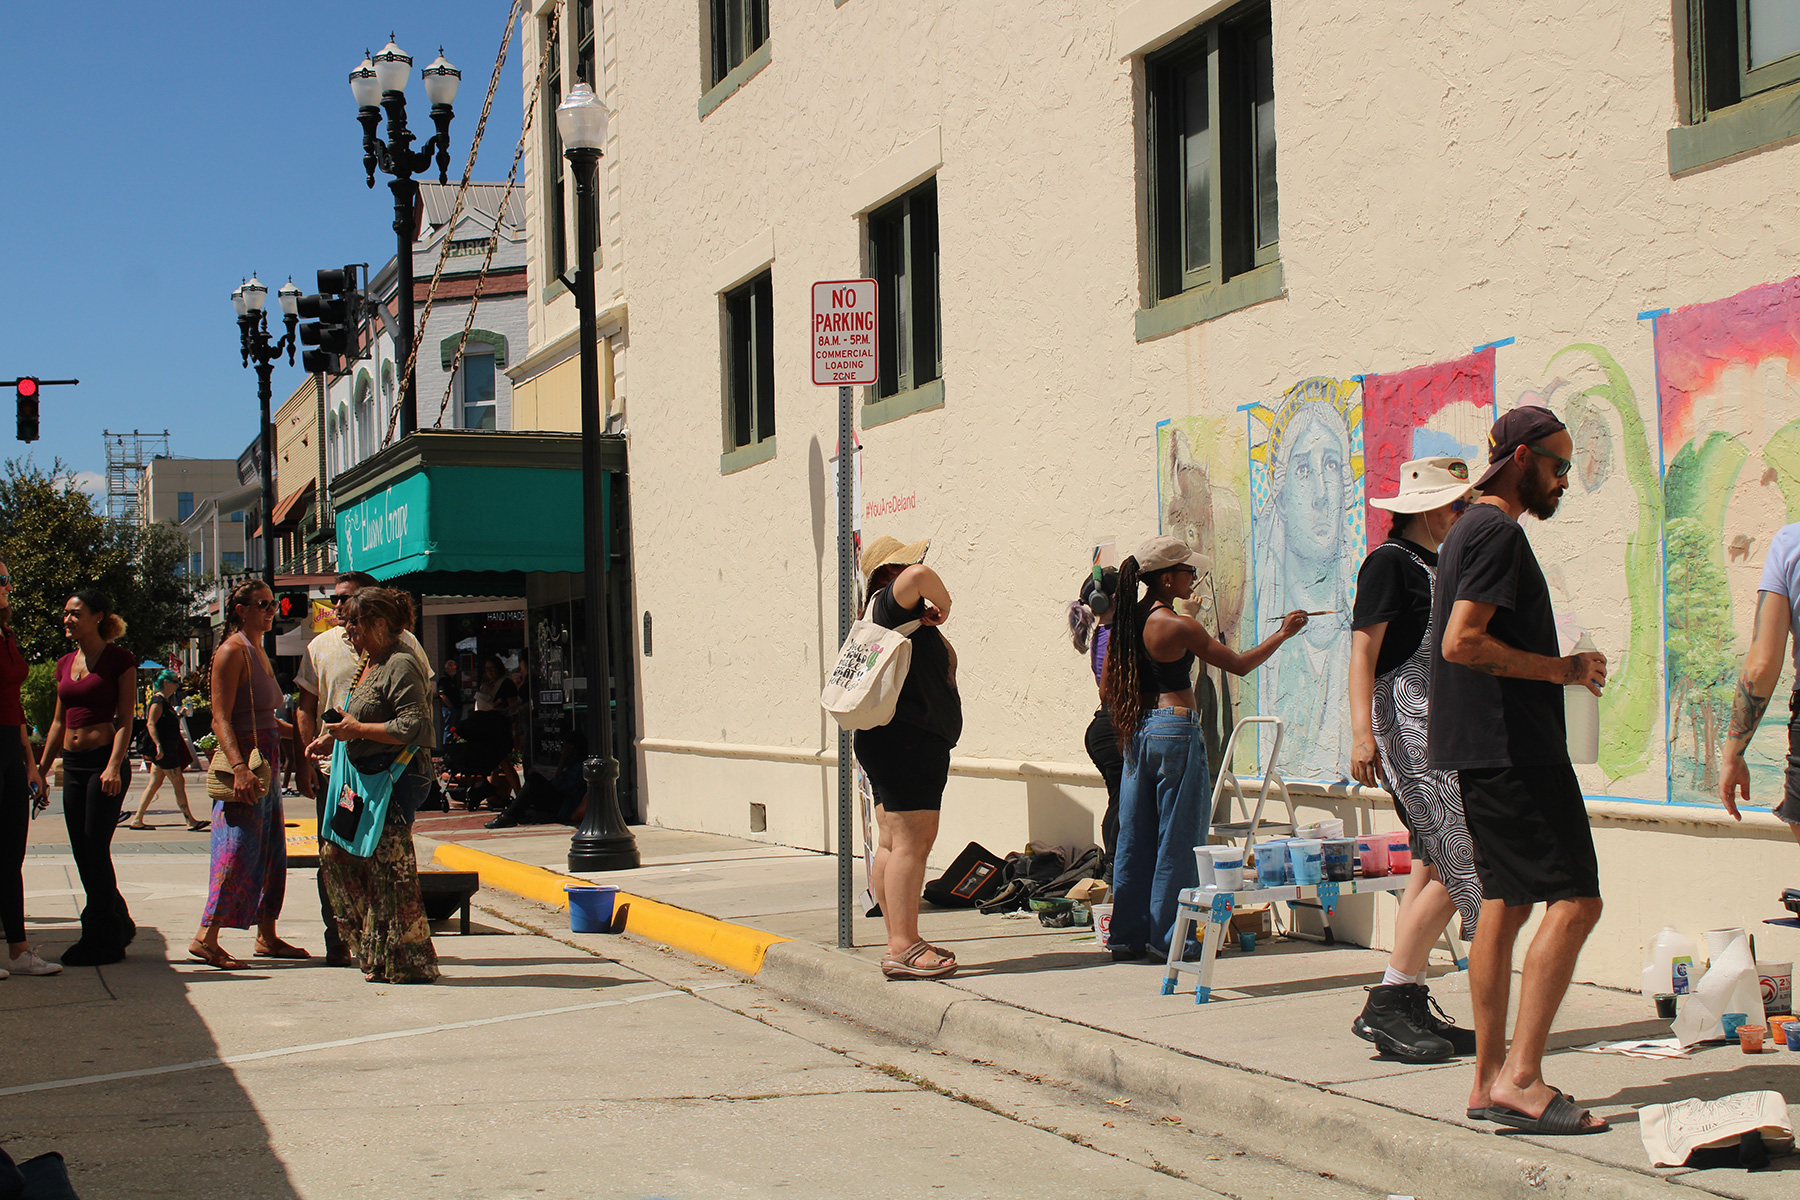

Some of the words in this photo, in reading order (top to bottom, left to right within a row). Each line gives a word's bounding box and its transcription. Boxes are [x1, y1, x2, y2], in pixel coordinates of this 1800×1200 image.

[832, 288, 856, 308] NO
[816, 311, 873, 332] PARKING
[816, 349, 873, 359] COMMERCIAL
[825, 361, 864, 370] LOADING
[833, 372, 856, 380] ZONE
[386, 485, 408, 559] Grape
[487, 612, 506, 621] HAND
[507, 611, 525, 620] MADE
